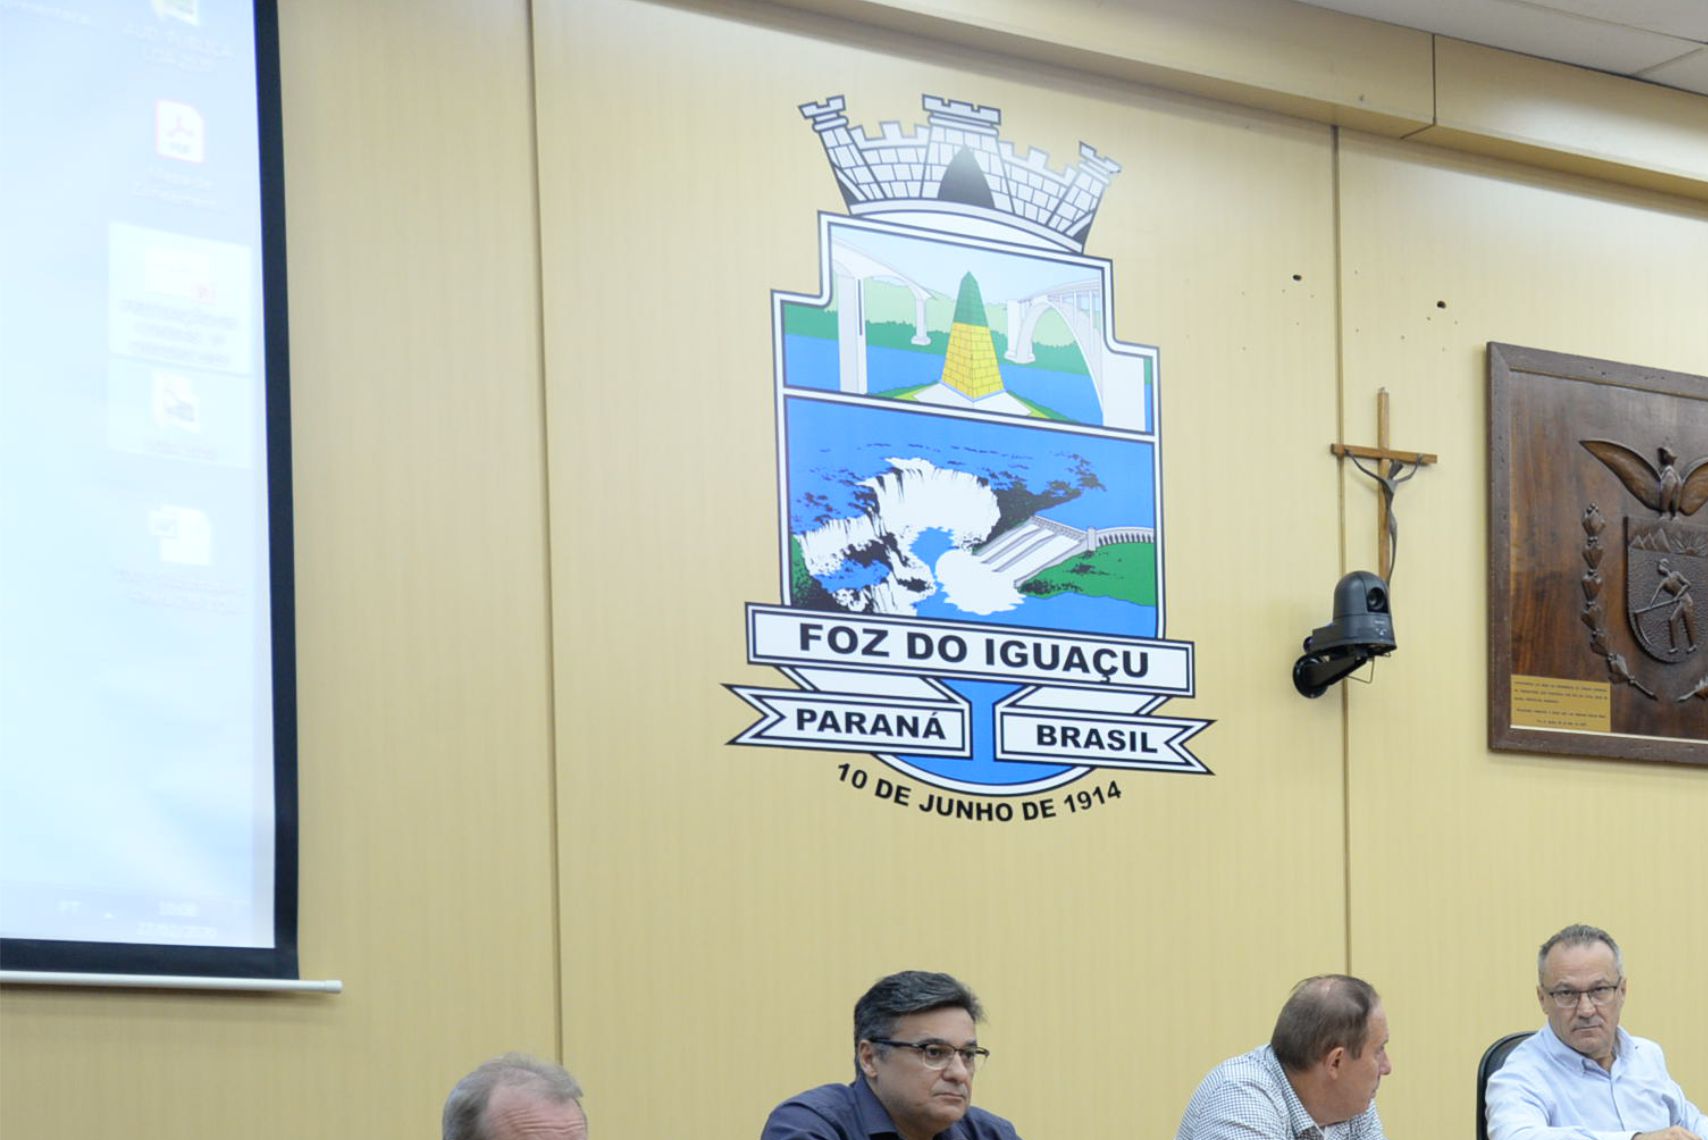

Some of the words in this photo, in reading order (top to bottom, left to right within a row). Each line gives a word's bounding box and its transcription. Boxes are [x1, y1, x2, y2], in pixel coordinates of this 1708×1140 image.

[800, 622, 890, 659] FOZ
[906, 631, 968, 663] DO
[985, 638, 1149, 684] IGUAÇU
[796, 708, 946, 740] PARANÁ
[1036, 723, 1158, 754] BRASIL
[837, 762, 868, 789] 10
[874, 778, 911, 807] DE
[918, 794, 1013, 822] JUNHO
[1022, 798, 1056, 820] DE
[1063, 780, 1121, 813] 1914
